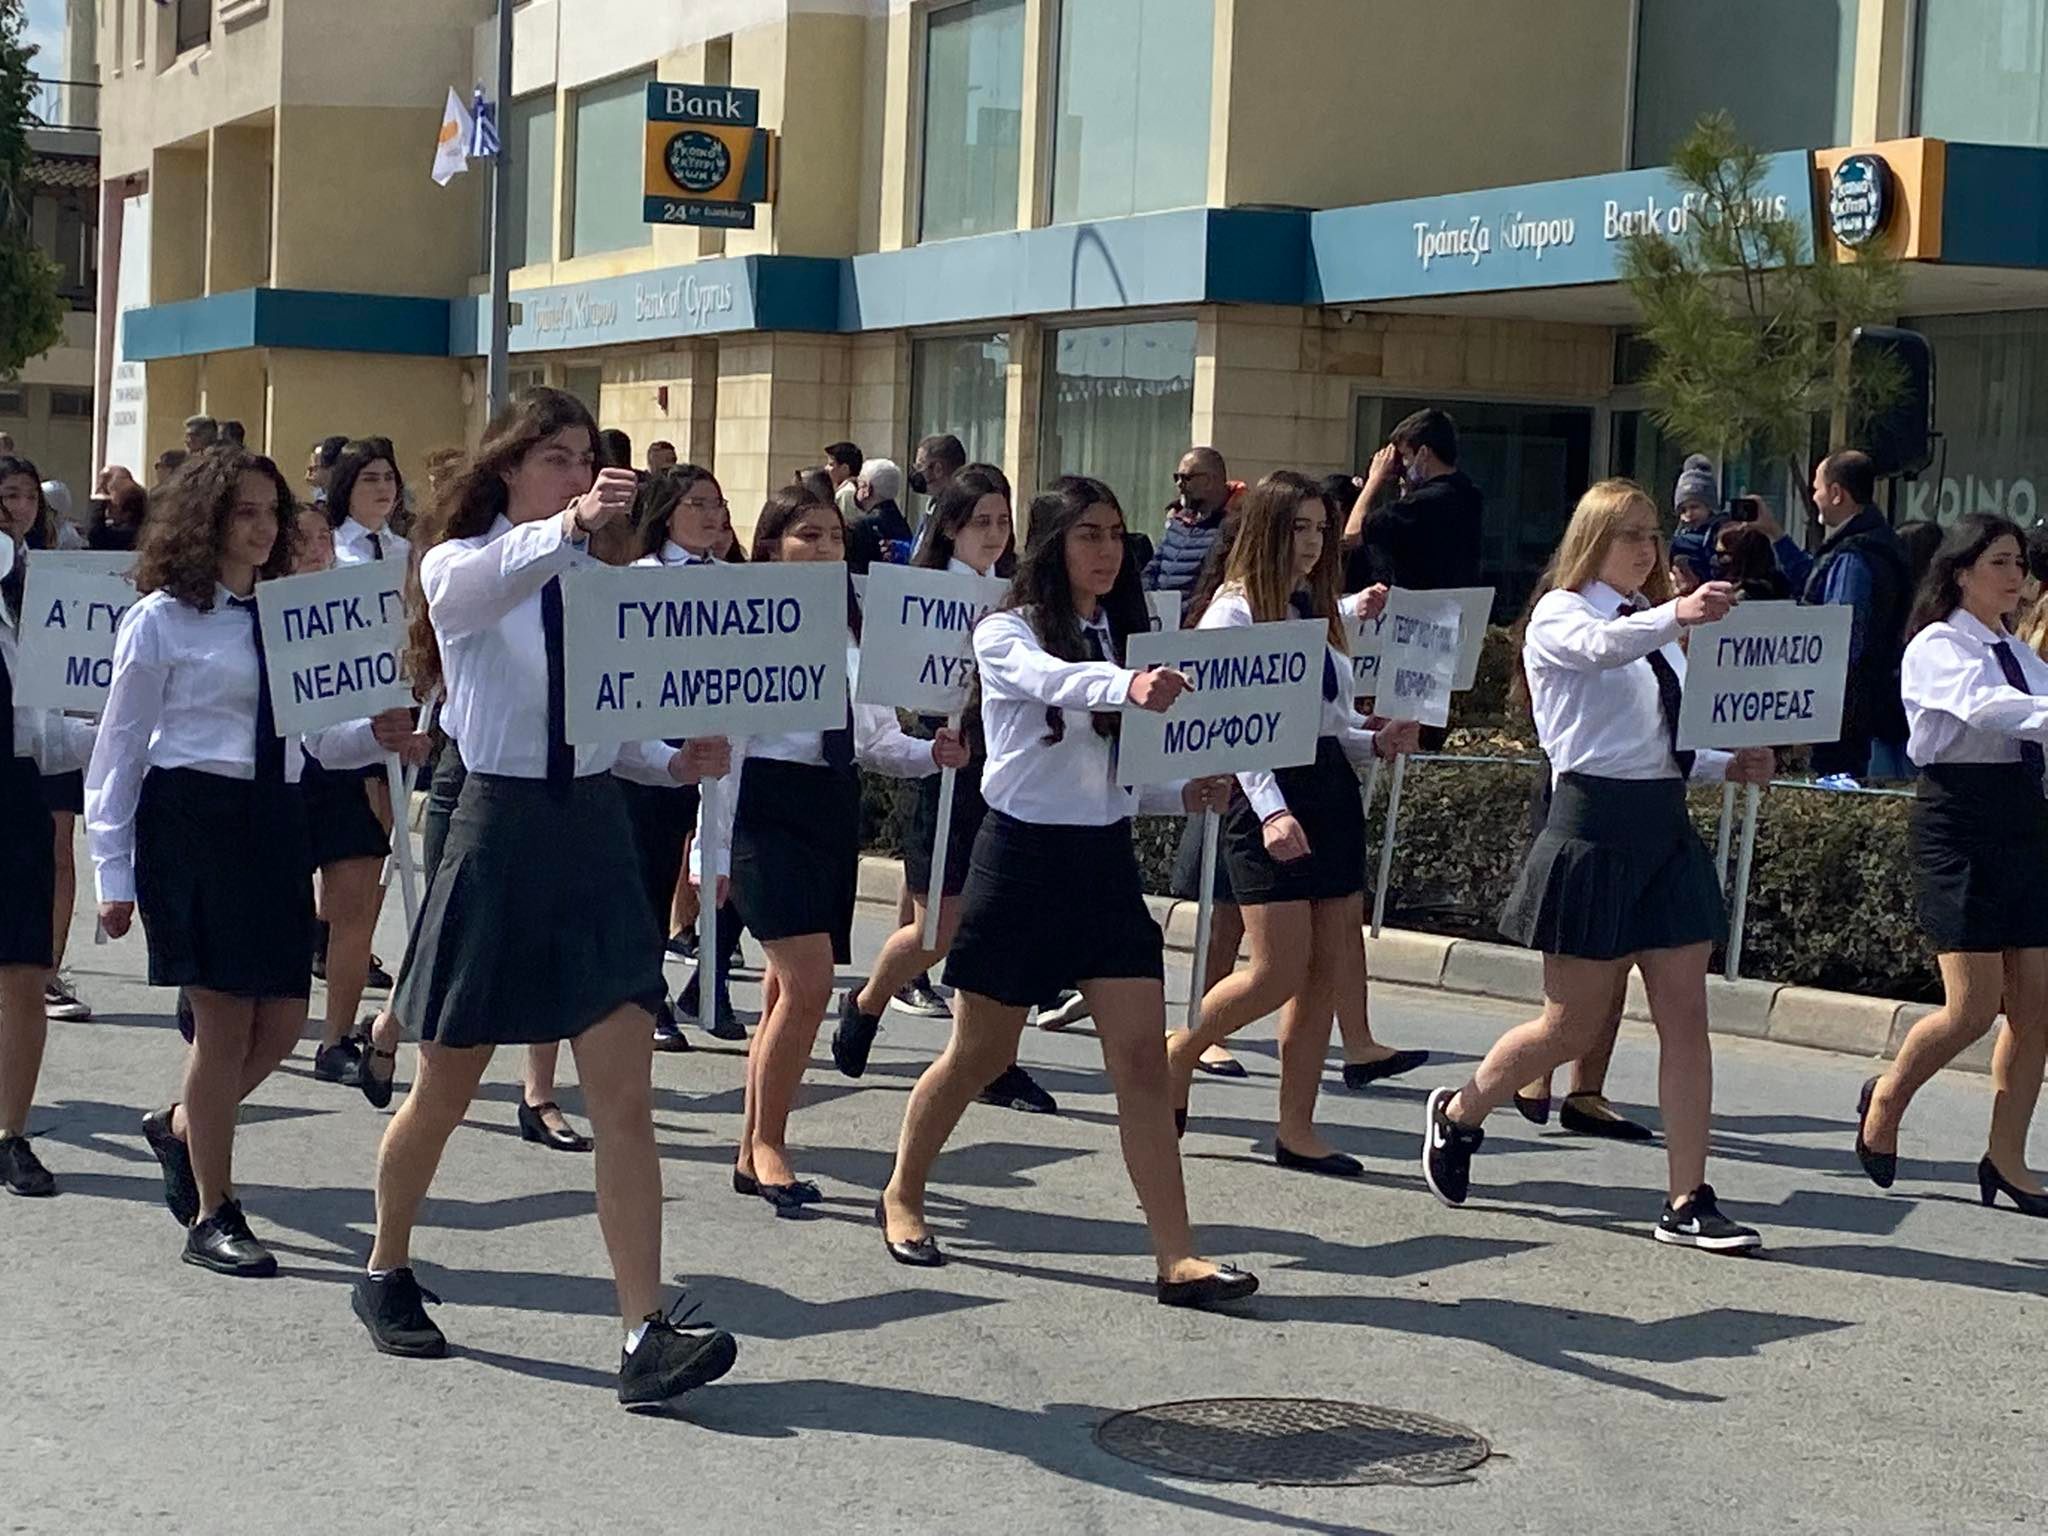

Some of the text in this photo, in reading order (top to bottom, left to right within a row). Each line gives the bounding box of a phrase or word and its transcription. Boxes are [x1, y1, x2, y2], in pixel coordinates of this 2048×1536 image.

[665, 87, 742, 119] Bank
[663, 203, 687, 220] 24
[1604, 197, 1663, 240] Bank
[1667, 192, 1695, 234] of
[1413, 211, 1576, 272] Τράπεζα Κύπρου
[635, 274, 733, 329] Bank of Cyprus
[283, 596, 372, 642] ΠΑΓΚ.
[617, 597, 802, 640] ΓΥΜΝΑΣΙΟ
[901, 595, 988, 632] ΓΥΜΝ
[1716, 634, 1823, 668] ΓΥΜΝΑΣΙΟ
[595, 663, 826, 711] ΑΓ. ΑΜΒΡΟΣΙΟΥ
[1711, 688, 1816, 723] ΚΥΘΡΕΑΣ
[1163, 711, 1282, 755] ΜΟΡΦΟΥ
